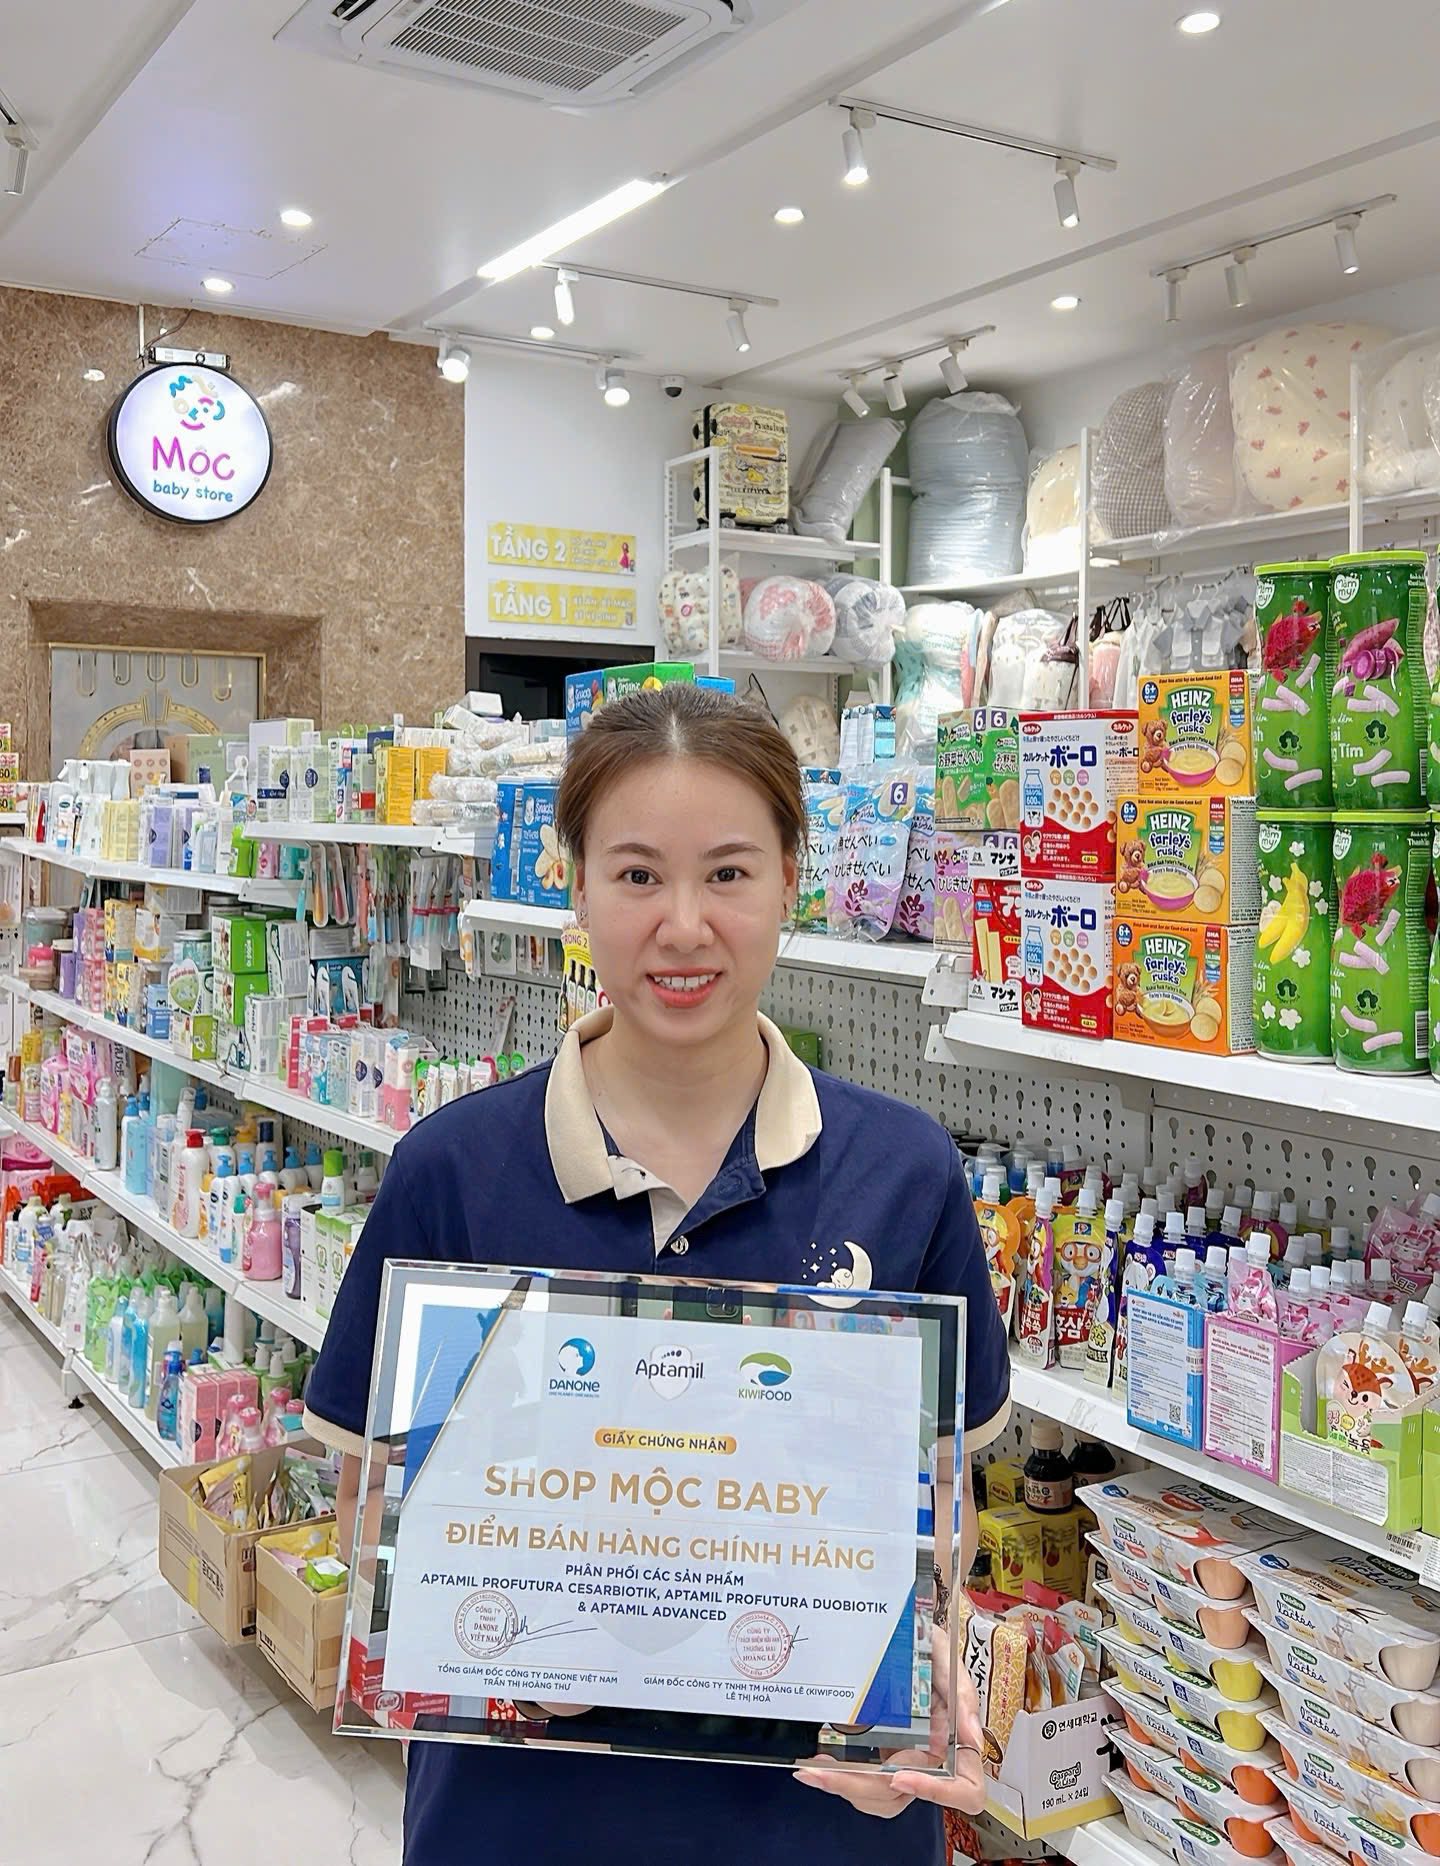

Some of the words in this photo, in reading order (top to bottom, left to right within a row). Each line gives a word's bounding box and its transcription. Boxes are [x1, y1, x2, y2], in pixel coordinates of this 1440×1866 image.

[153, 480, 190, 500] baby
[196, 487, 234, 502] store
[555, 540, 566, 563] 2
[559, 597, 568, 620] 1
[618, 682, 641, 693] Organic
[1144, 684, 1156, 694] 6+
[1171, 690, 1211, 708] HEINZ
[975, 710, 984, 730] 6
[993, 712, 1004, 727] 6
[1171, 709, 1211, 725] farley's
[1178, 723, 1204, 734] rusks
[1023, 753, 1049, 762] カルケット
[1050, 745, 1097, 768] ボーロ
[894, 785, 904, 802] 6
[535, 803, 554, 814] Snacks
[1123, 803, 1135, 813] 6+
[1150, 813, 1191, 831] HEINZ
[1150, 831, 1191, 848] farley's
[991, 852, 1015, 865] マンナ
[1157, 846, 1184, 858] rusks
[1024, 909, 1051, 920] カルケット
[1051, 905, 1097, 930] ボーロ
[1119, 925, 1130, 935] 6+
[1145, 938, 1186, 958] HEINZ
[1145, 957, 1186, 975] farley's
[1153, 972, 1179, 984] rusks
[991, 986, 1015, 1000] マンナ
[635, 1359, 704, 1379] Aptamil
[738, 1388, 792, 1402] KIWIFOOD
[603, 1429, 634, 1446] GIẤY
[638, 1431, 685, 1450] CHỨNG
[689, 1437, 727, 1453] NHẬN
[484, 1465, 596, 1501] SHOP
[610, 1467, 703, 1515] MỘC
[717, 1479, 829, 1516] BABY
[445, 1514, 519, 1548] ĐIỂM
[528, 1525, 589, 1552] BÁN
[598, 1530, 681, 1559] HÀNG
[689, 1534, 782, 1565] CHÍNH
[791, 1538, 875, 1570] HÃNG
[565, 1564, 601, 1577] PHÂN
[606, 1564, 639, 1579] PHỐI
[642, 1567, 670, 1582] CÁC
[674, 1570, 702, 1583] SẢN
[705, 1570, 744, 1587] PHẨM
[420, 1573, 478, 1587] APTAMIL
[482, 1577, 564, 1593] PROFUTURA
[567, 1585, 661, 1601] CESARBIOTIK,
[664, 1589, 722, 1603] APTAMIL
[726, 1593, 808, 1609] PROFUTURA
[812, 1598, 888, 1614] DUOBIOTIK
[578, 1601, 586, 1612] &
[590, 1602, 648, 1617] APTAMIL
[652, 1606, 727, 1621] ADVANCED
[474, 1623, 498, 1632] DANONE
[463, 1665, 483, 1676] GIÁM
[485, 1664, 504, 1677] ĐỐC
[505, 1667, 529, 1679] CÔNG
[531, 1671, 541, 1680] TY
[543, 1672, 578, 1681] DANONE
[579, 1672, 598, 1683] VIỆT
[599, 1675, 618, 1684] NAM
[508, 1680, 521, 1689] THỊ
[522, 1680, 552, 1691] HOÀNG
[554, 1680, 571, 1691] THƯ
[644, 1676, 665, 1686] GIÁM
[666, 1676, 685, 1688] ĐỐC
[687, 1677, 711, 1689] CÔNG
[712, 1681, 723, 1690] TY
[725, 1682, 747, 1691] TNHH
[749, 1684, 761, 1692] TM
[762, 1682, 792, 1694] HOÀNG
[794, 1684, 804, 1695] LÊ
[805, 1687, 855, 1699] (KIWIFOOD)
[725, 1691, 736, 1701] LÊ
[738, 1692, 751, 1703] THỊ
[1059, 1712, 1097, 1731] 연세대학교
[1042, 1798, 1054, 1809] 190
